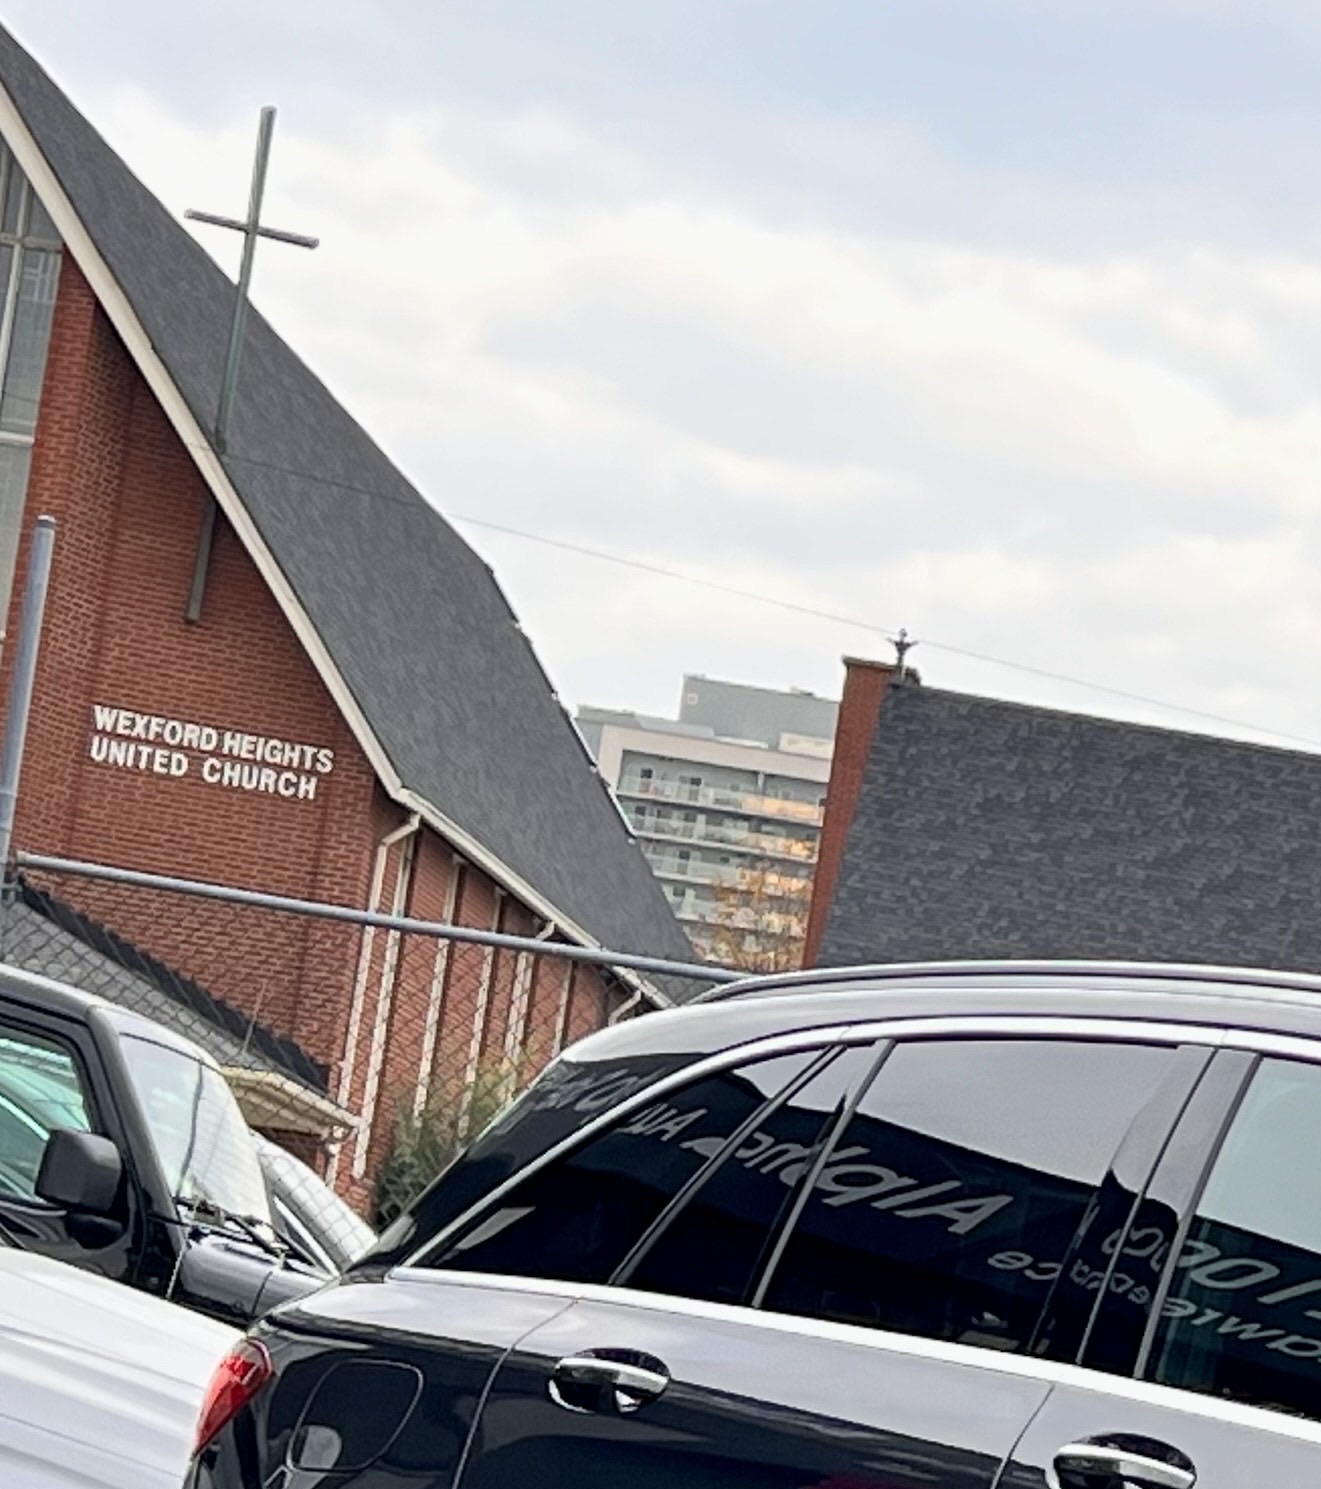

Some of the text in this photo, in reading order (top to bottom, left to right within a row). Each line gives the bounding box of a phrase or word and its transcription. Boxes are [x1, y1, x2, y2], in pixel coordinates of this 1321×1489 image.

[90, 735, 318, 800] UNITED CHURCH
[93, 704, 334, 773] WEXFORD HEIGHTS
